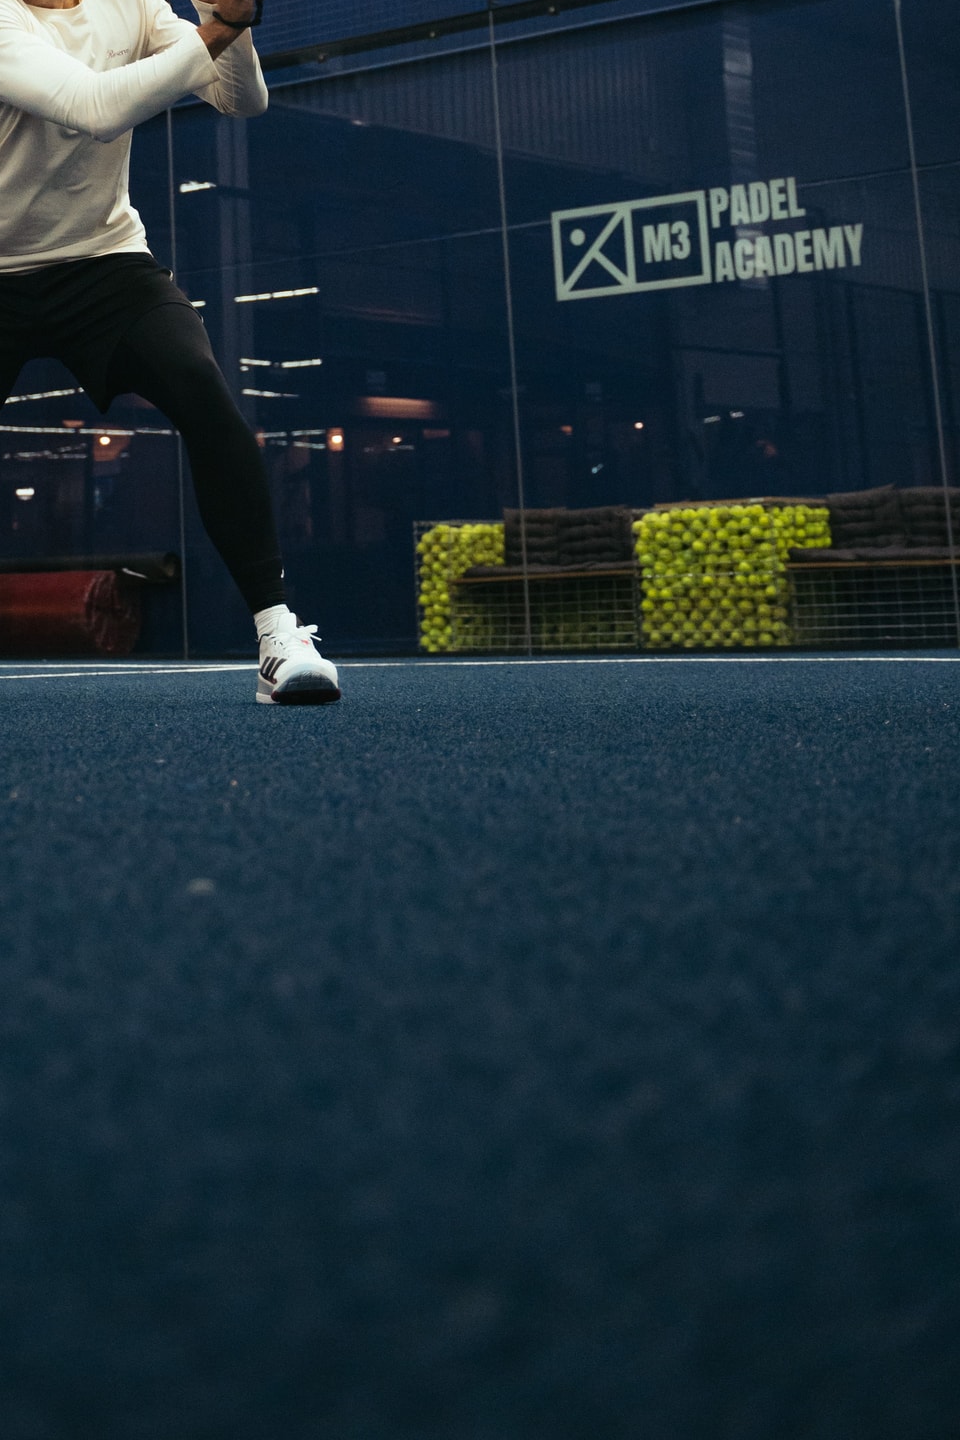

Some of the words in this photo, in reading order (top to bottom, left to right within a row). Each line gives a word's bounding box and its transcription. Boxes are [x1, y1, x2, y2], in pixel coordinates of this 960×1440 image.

[709, 177, 806, 229] PADEL
[642, 221, 691, 263] M3
[714, 223, 864, 283] ACADEMY
